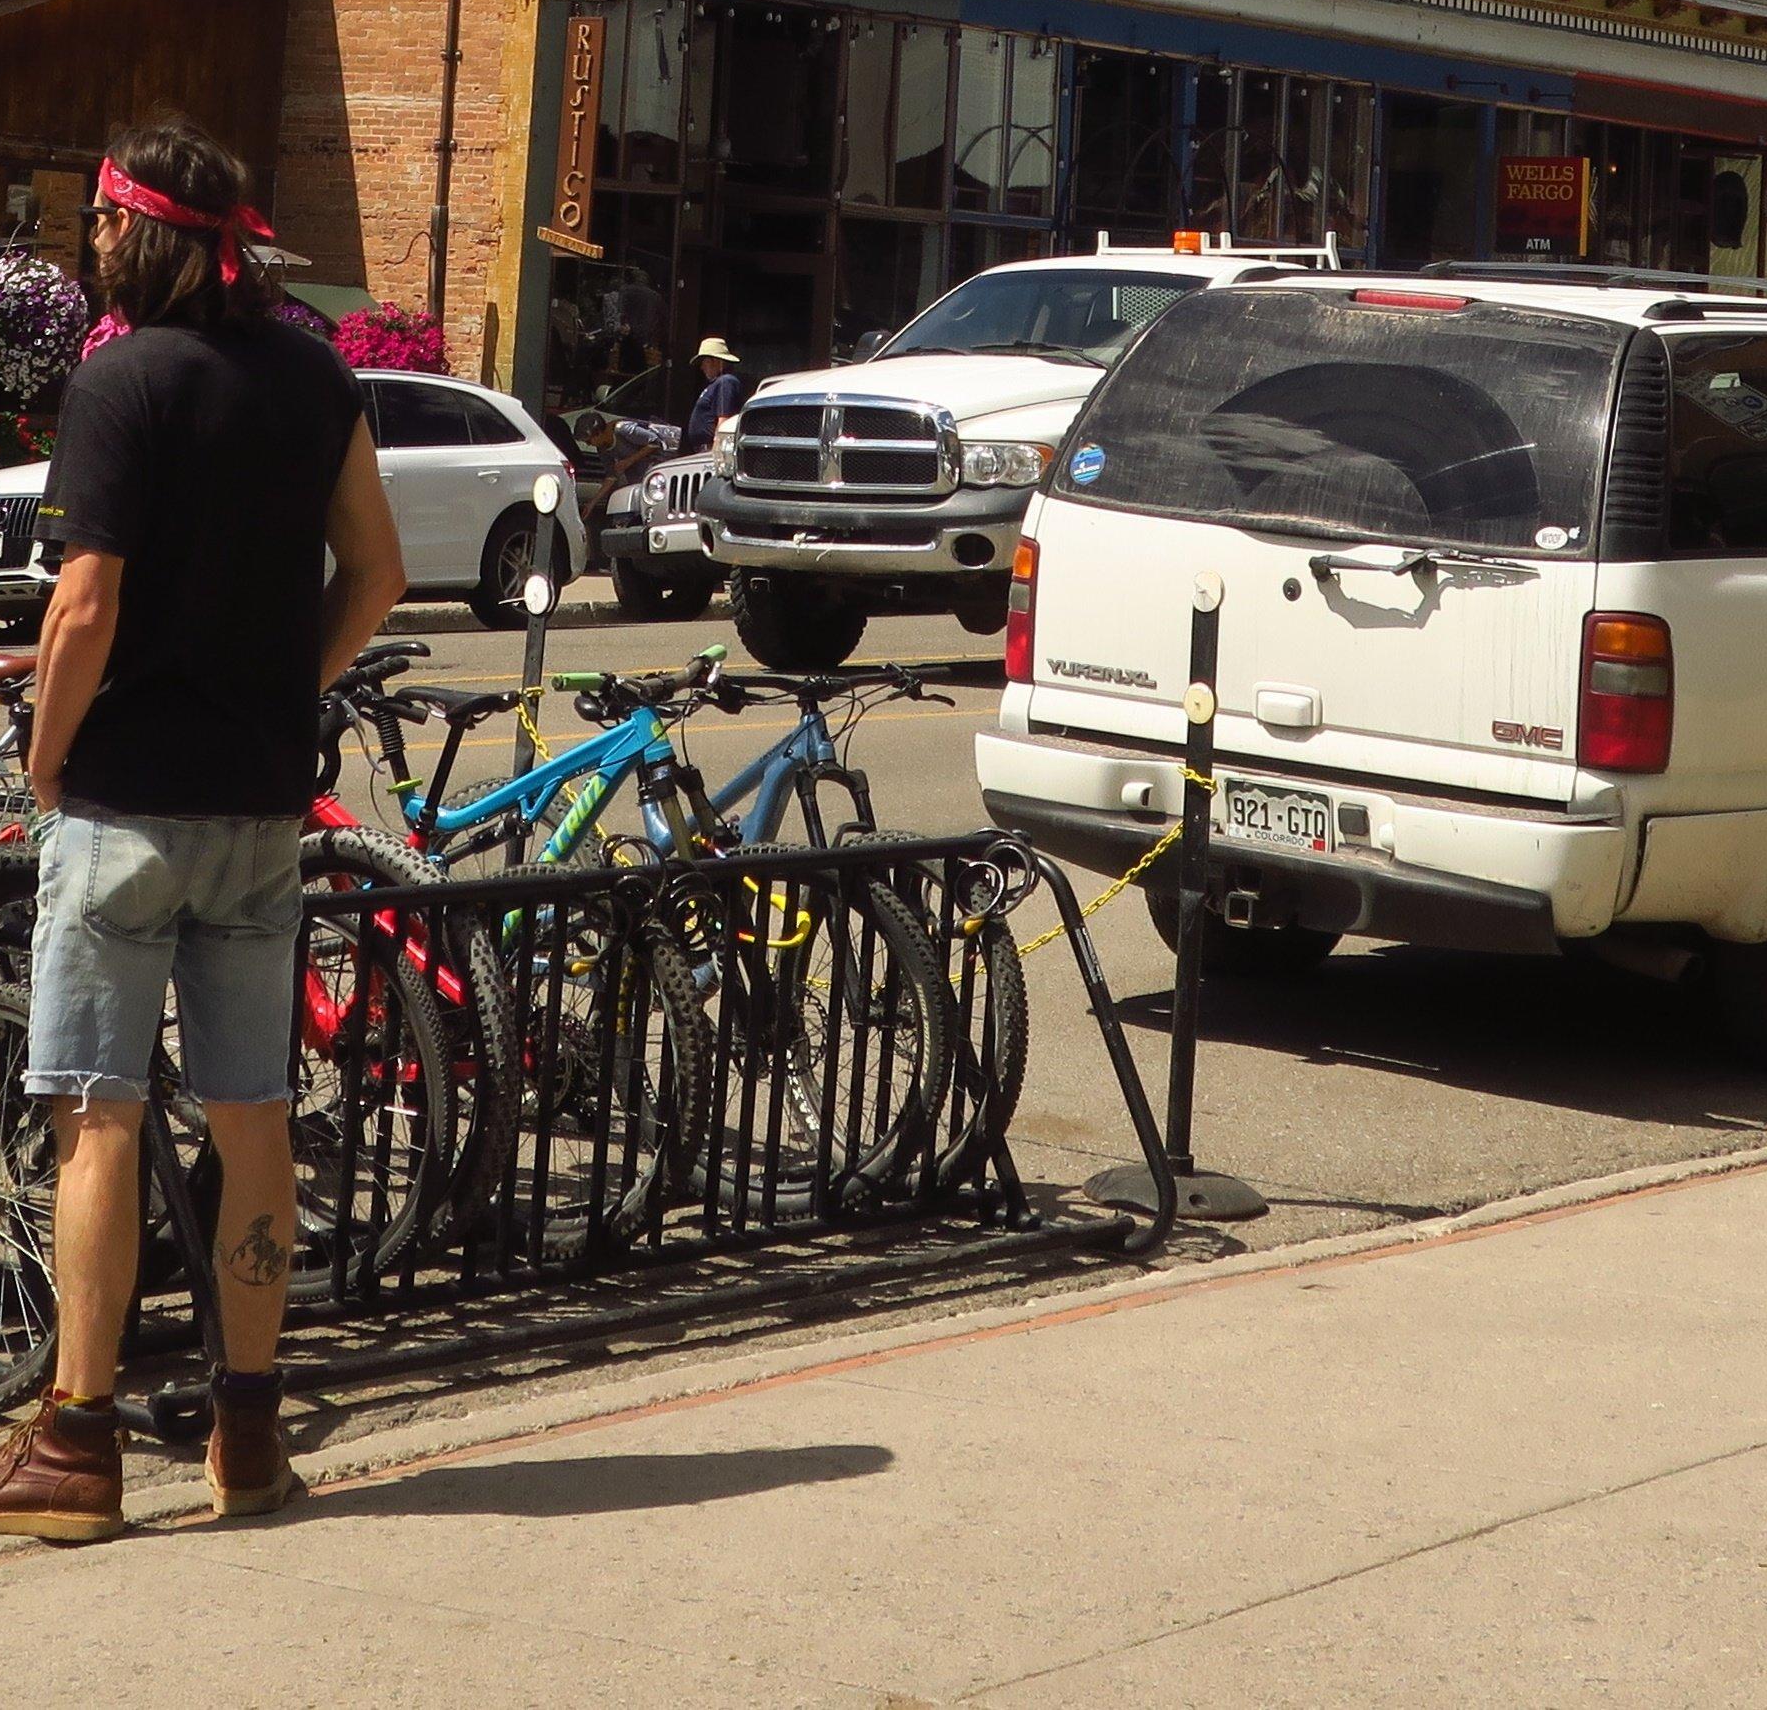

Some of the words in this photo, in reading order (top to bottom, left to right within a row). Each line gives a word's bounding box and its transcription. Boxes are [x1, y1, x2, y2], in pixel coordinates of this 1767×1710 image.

[559, 24, 592, 228] RUSTICO
[1506, 165, 1574, 182] WELLS
[1507, 183, 1573, 201] FARGO
[1526, 238, 1551, 251] ATM
[1046, 658, 1122, 684] YUKON
[1120, 668, 1157, 690] XL
[1492, 720, 1563, 751] GMC
[1254, 831, 1305, 846] COLORADO
